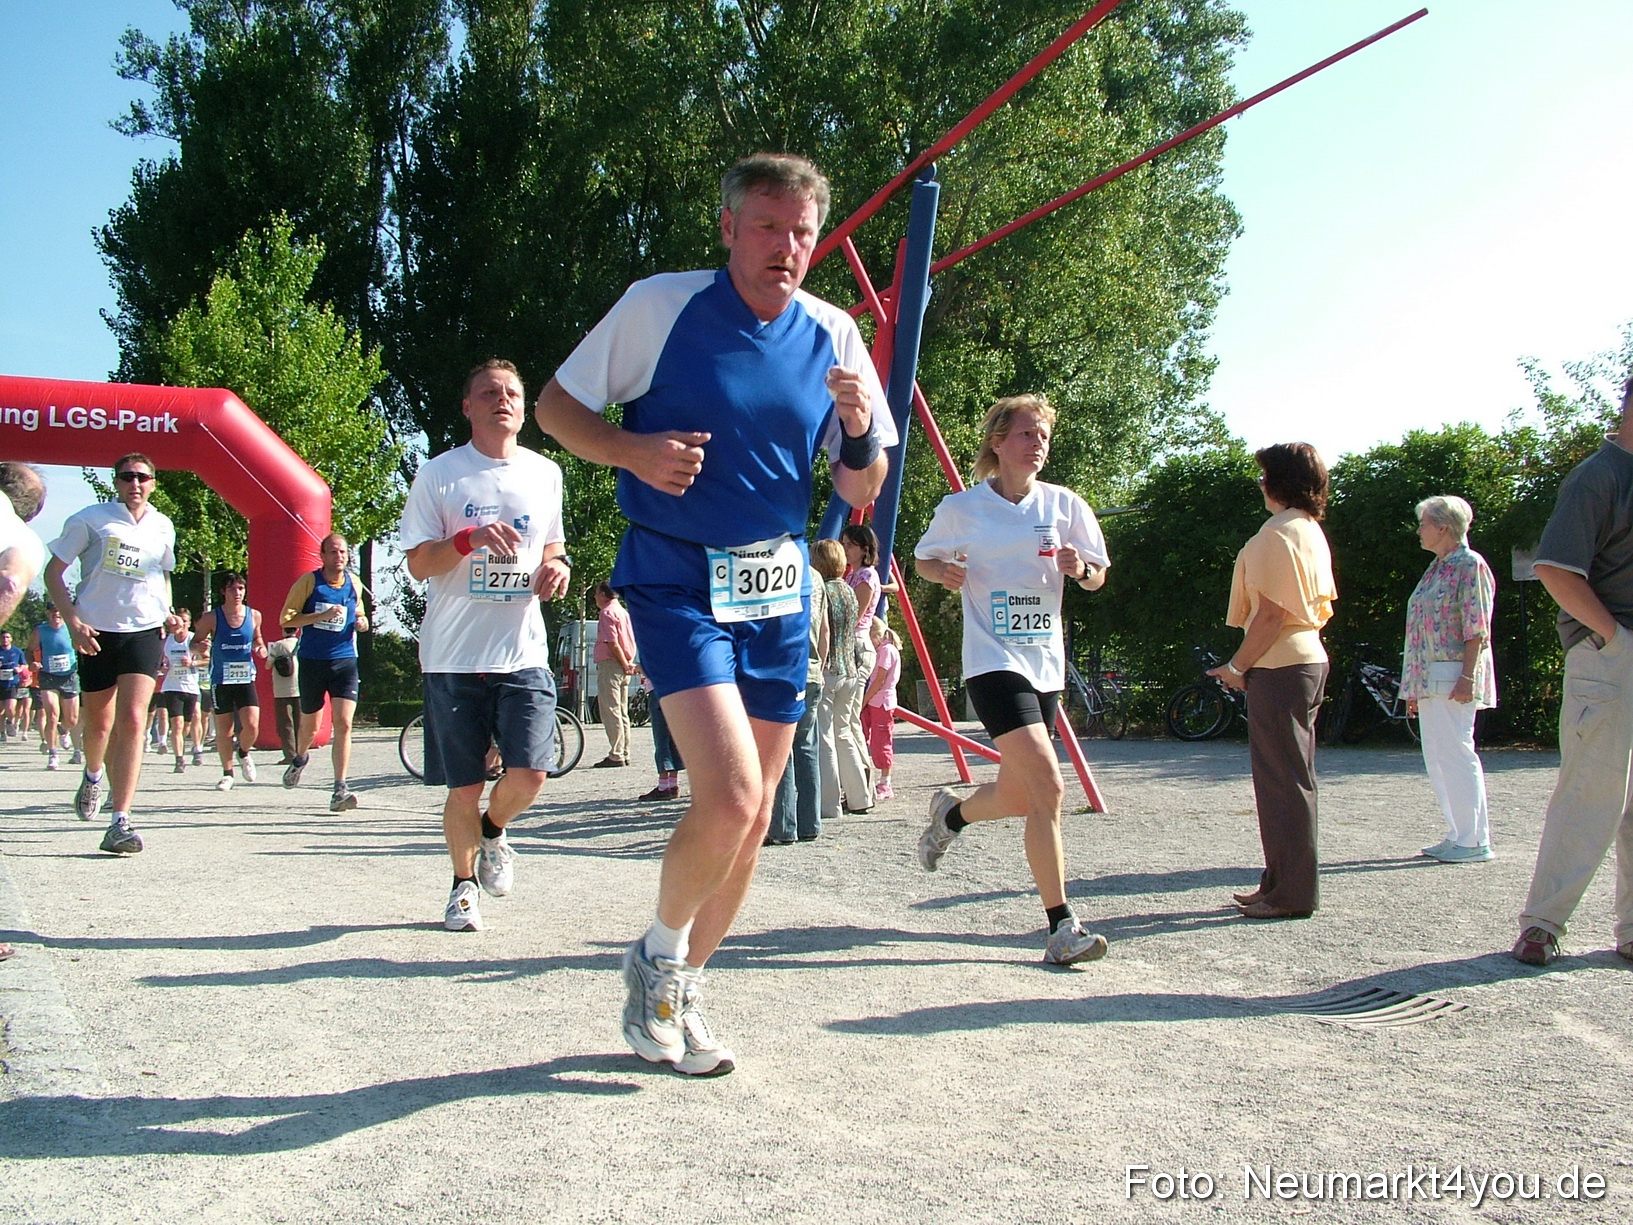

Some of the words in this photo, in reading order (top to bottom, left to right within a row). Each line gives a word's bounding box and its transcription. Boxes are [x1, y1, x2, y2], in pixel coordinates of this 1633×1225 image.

[0, 407, 40, 431] ng
[49, 405, 179, 434] LGS-Park
[119, 543, 141, 553] Martin
[117, 554, 140, 569] 504
[474, 567, 482, 577] C
[488, 572, 530, 588] 2779
[716, 565, 727, 580] C
[738, 564, 797, 595] 3020
[1008, 595, 1041, 606] Christa
[322, 615, 344, 625] 299
[995, 611, 1004, 621] C
[1011, 613, 1051, 631] 2126
[230, 670, 248, 678] 2133
